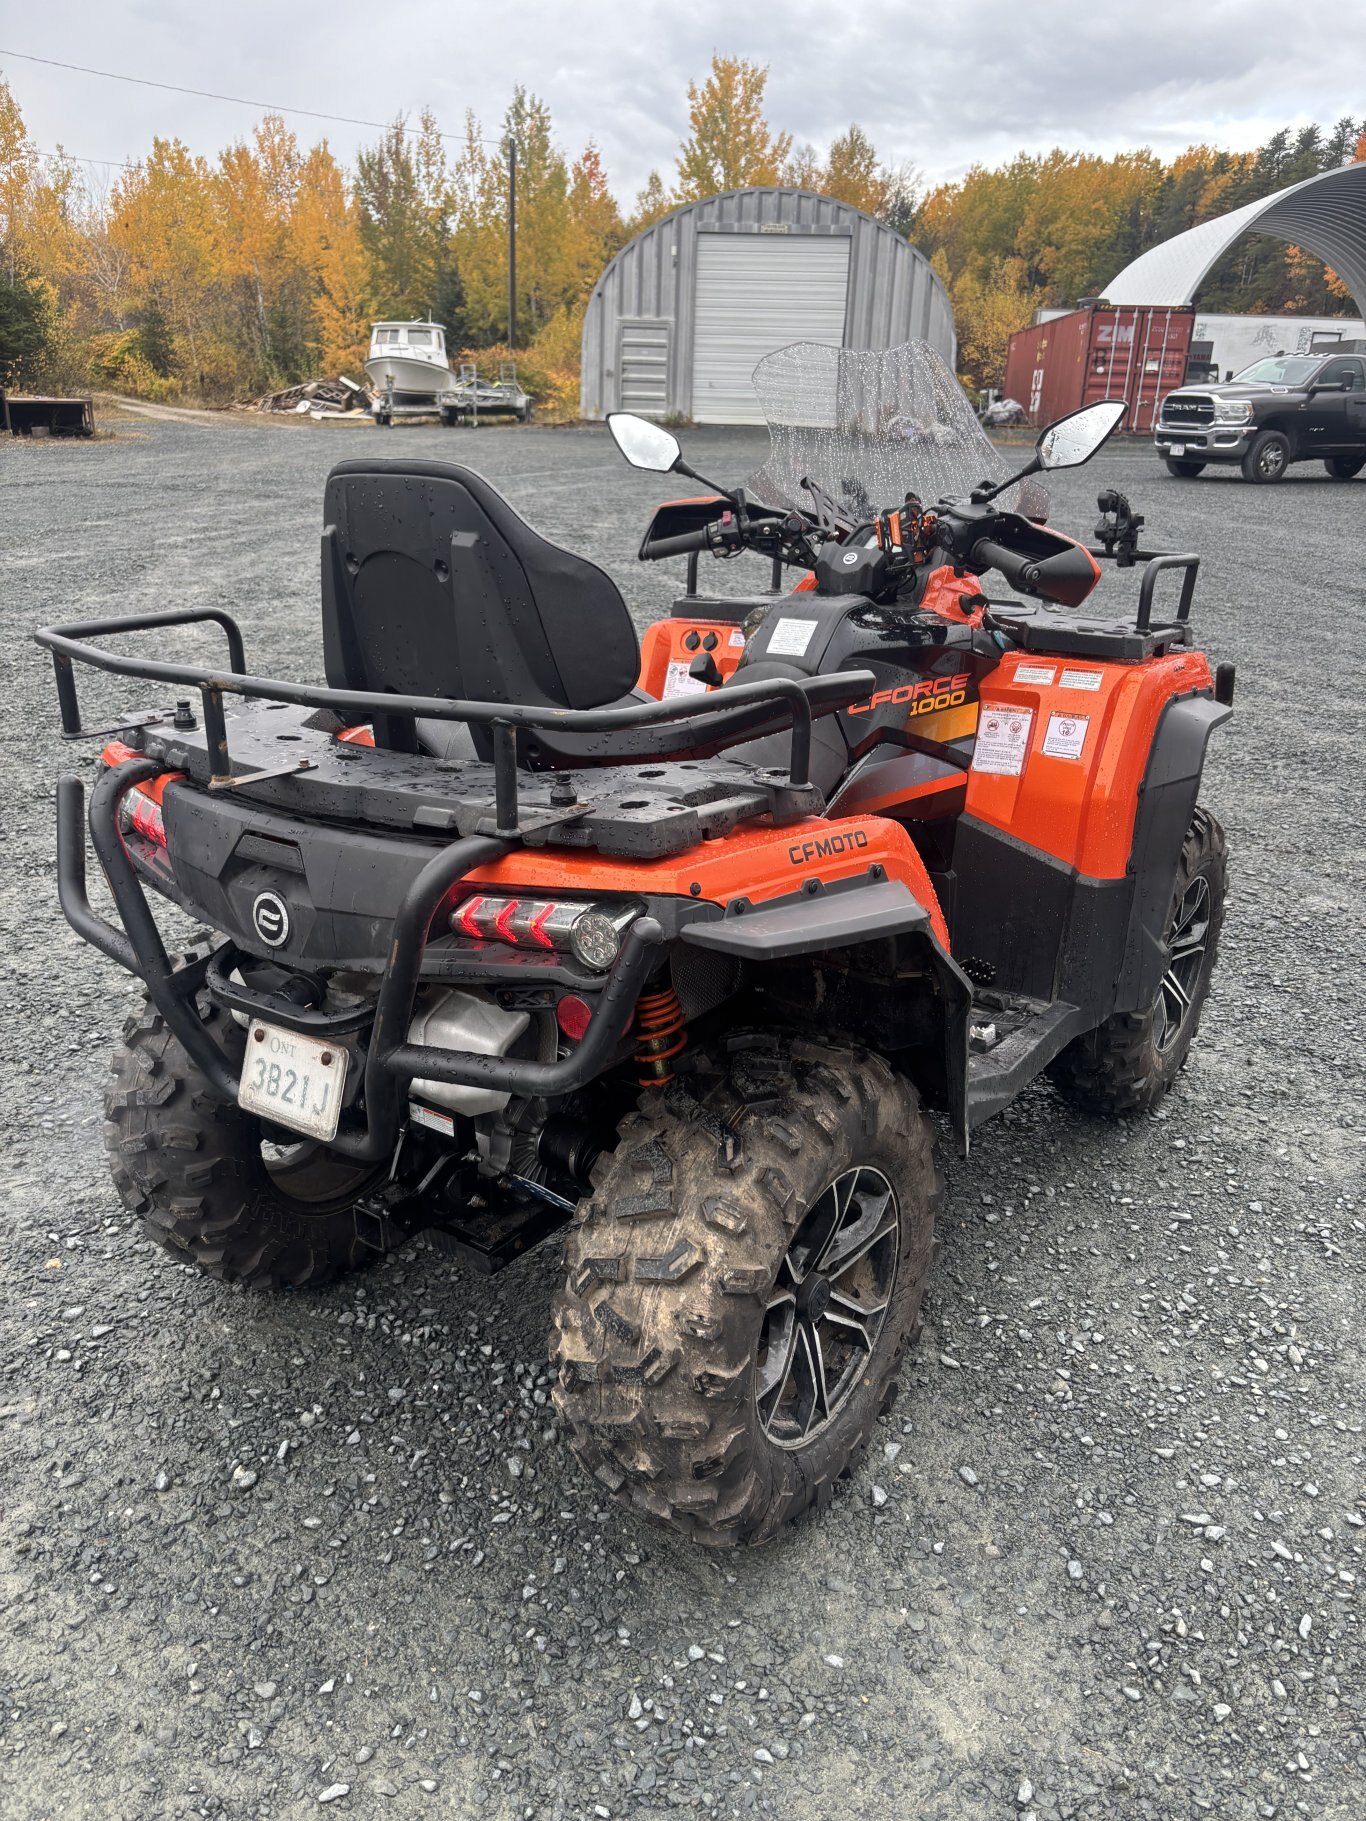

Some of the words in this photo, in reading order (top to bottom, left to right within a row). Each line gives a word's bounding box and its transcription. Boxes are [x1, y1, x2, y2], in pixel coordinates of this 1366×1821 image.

[1097, 325, 1136, 342] ZIM
[909, 690, 965, 716] 1000
[788, 830, 868, 865] CFMOTO
[270, 1036, 297, 1058] ONT
